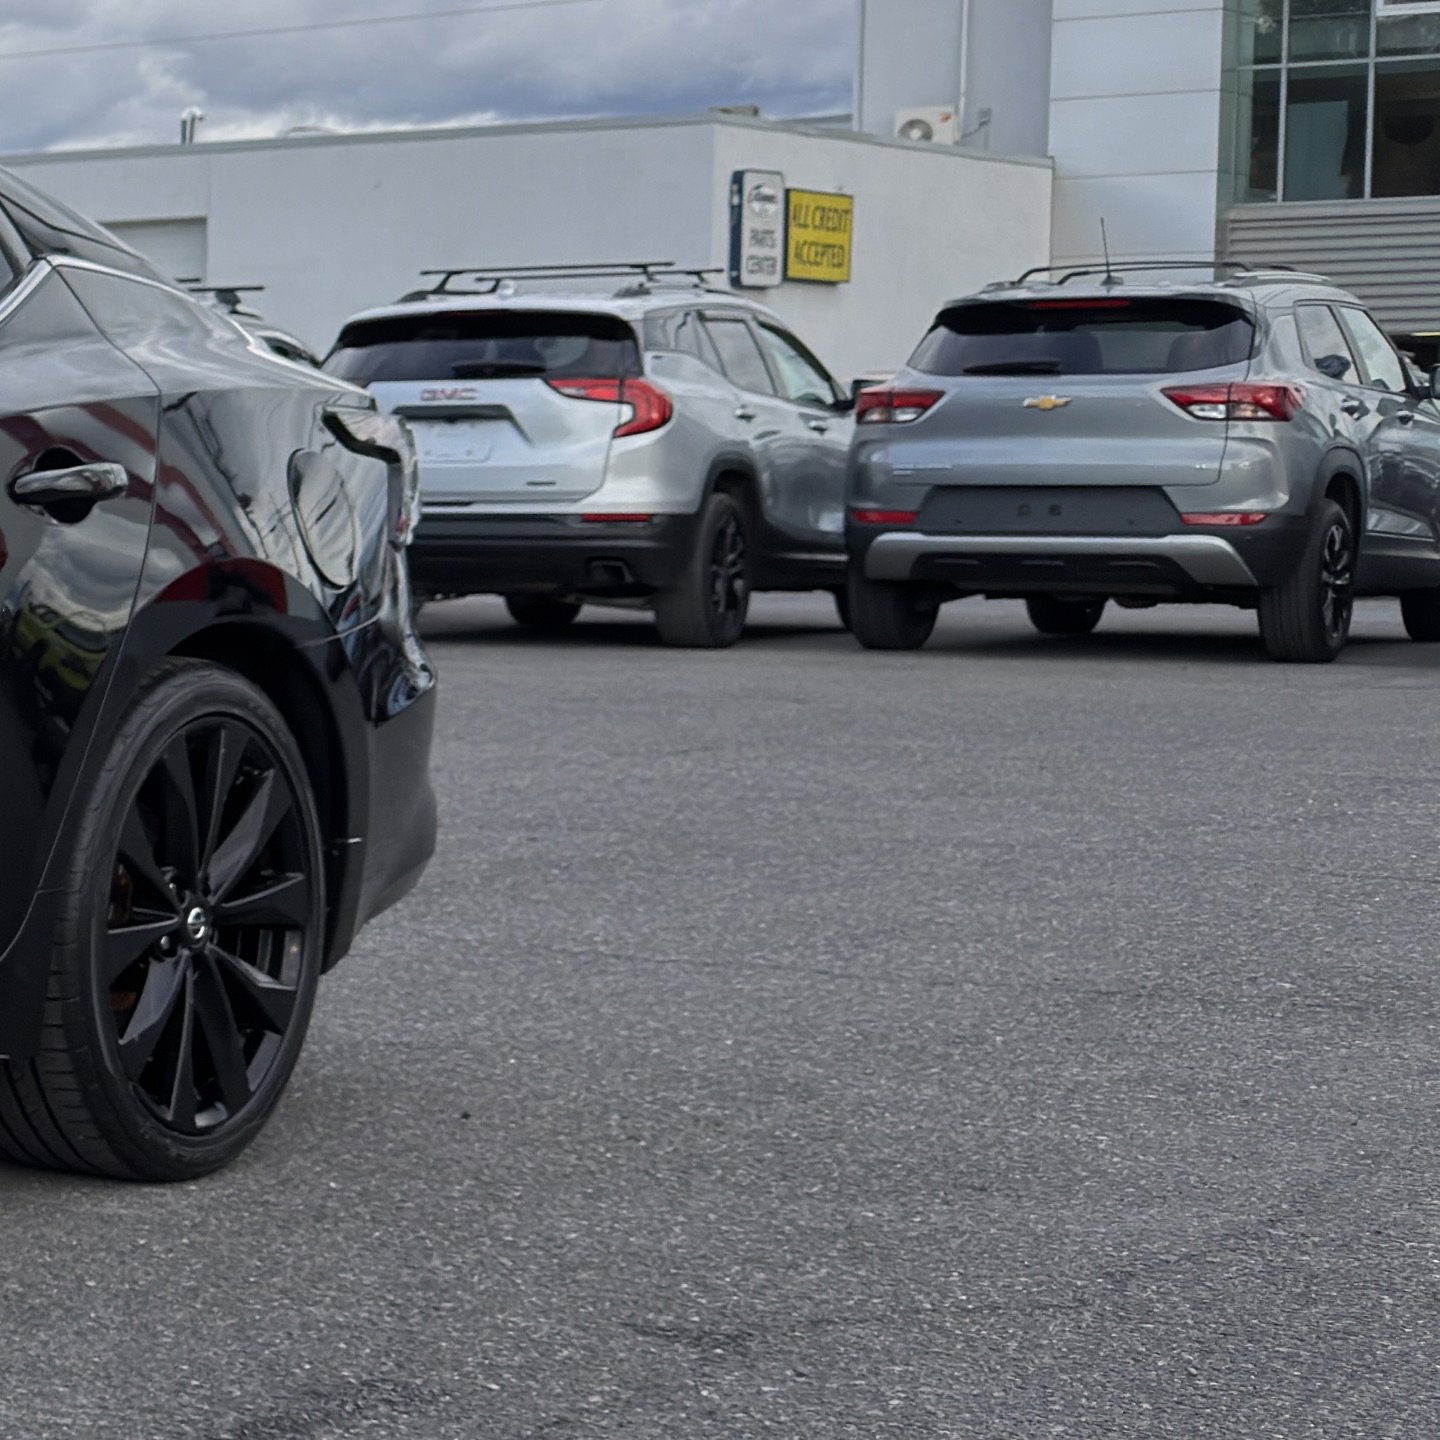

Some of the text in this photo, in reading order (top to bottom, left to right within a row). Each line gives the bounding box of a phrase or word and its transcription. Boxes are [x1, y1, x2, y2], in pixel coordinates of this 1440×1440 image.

[792, 205, 849, 233] ALL CREDIT
[794, 241, 845, 268] ACCEPTED
[421, 388, 478, 401] GMC
